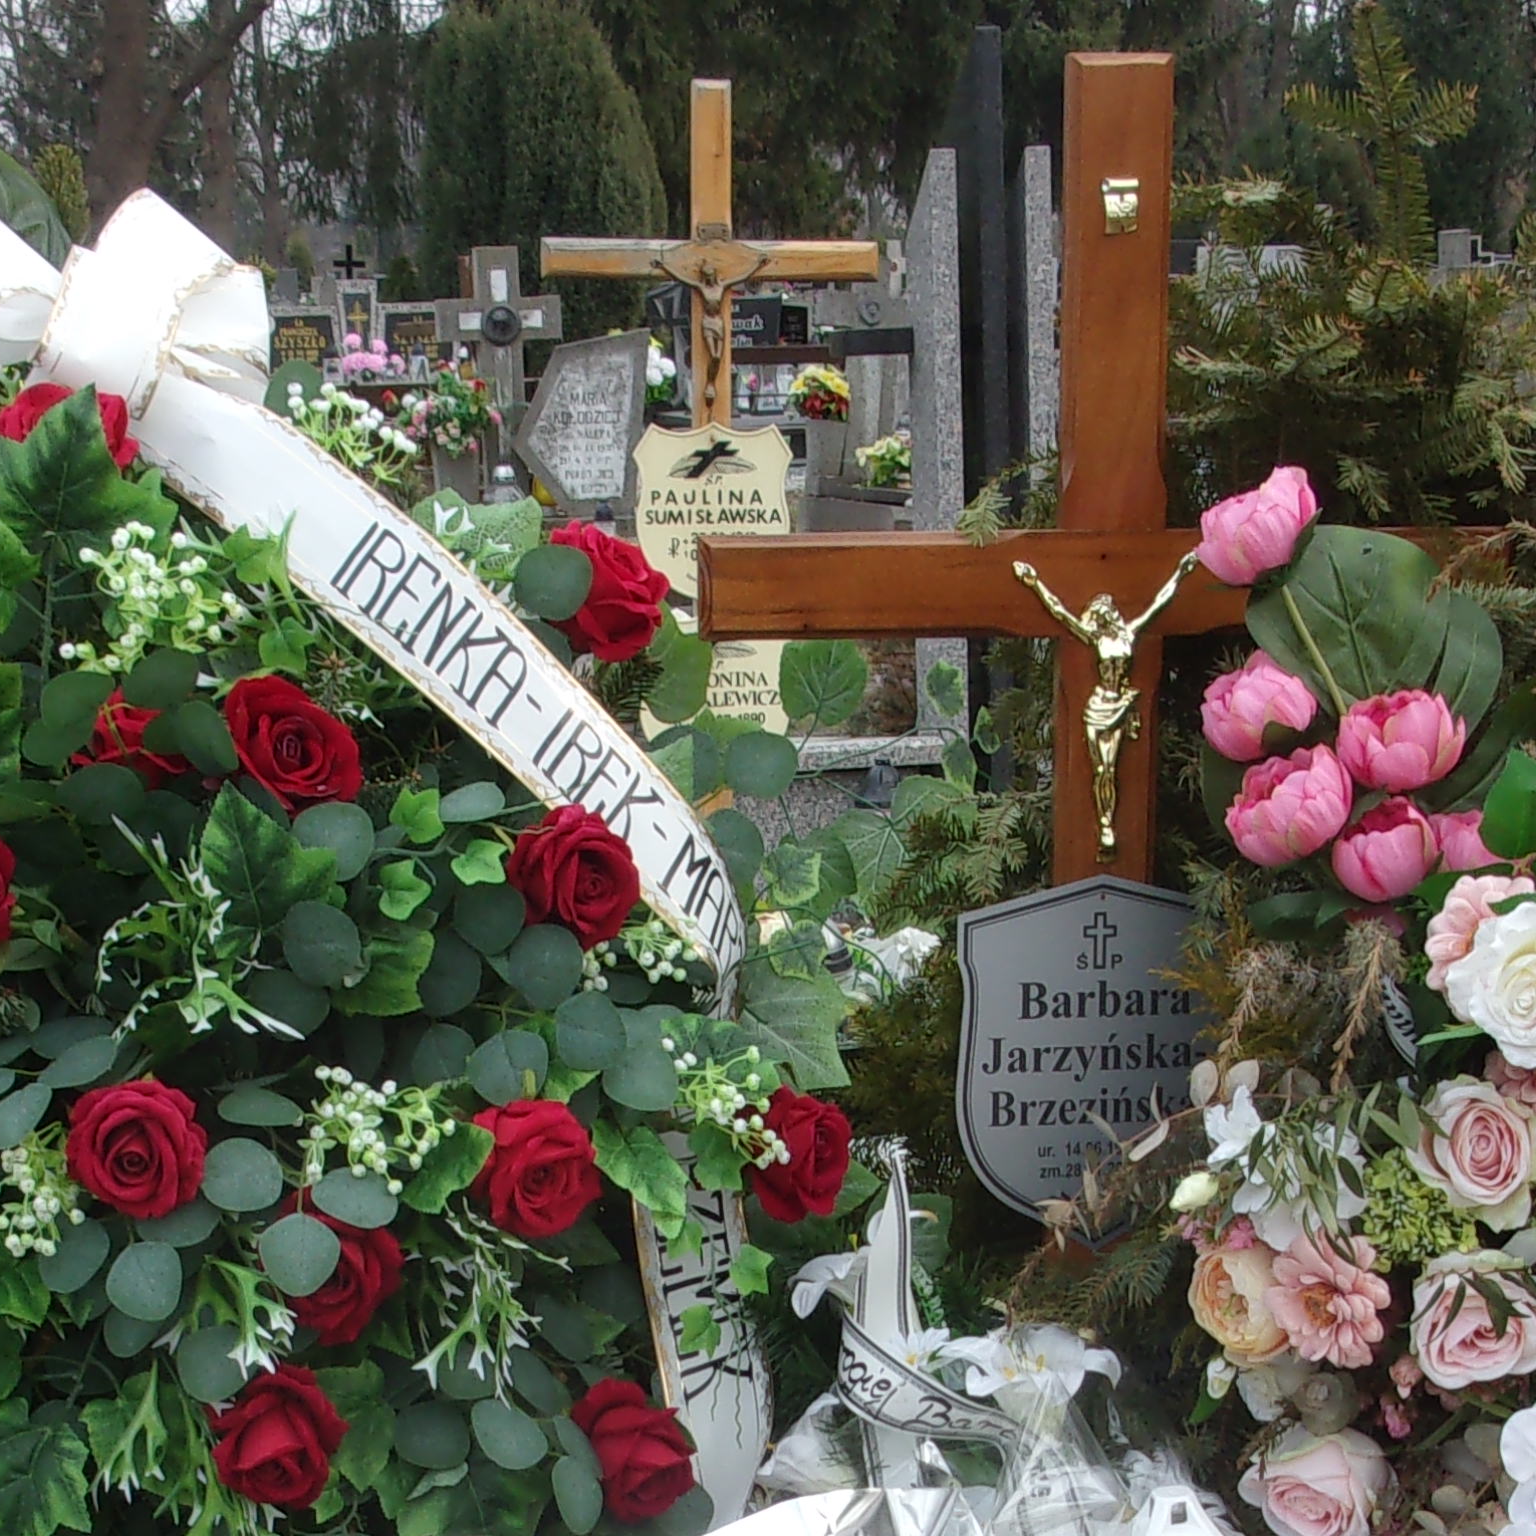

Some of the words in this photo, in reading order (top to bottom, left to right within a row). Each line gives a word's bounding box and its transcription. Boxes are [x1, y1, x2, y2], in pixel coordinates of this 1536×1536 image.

[650, 489, 764, 505] PAULINA
[645, 508, 783, 525] SUMISŁAWSKA
[708, 671, 768, 688] ONINA
[1076, 952, 1089, 970] Ś
[1110, 955, 1123, 970] P
[1018, 980, 1192, 1021] Barbara
[989, 1087, 1191, 1128] Brzezińsk
